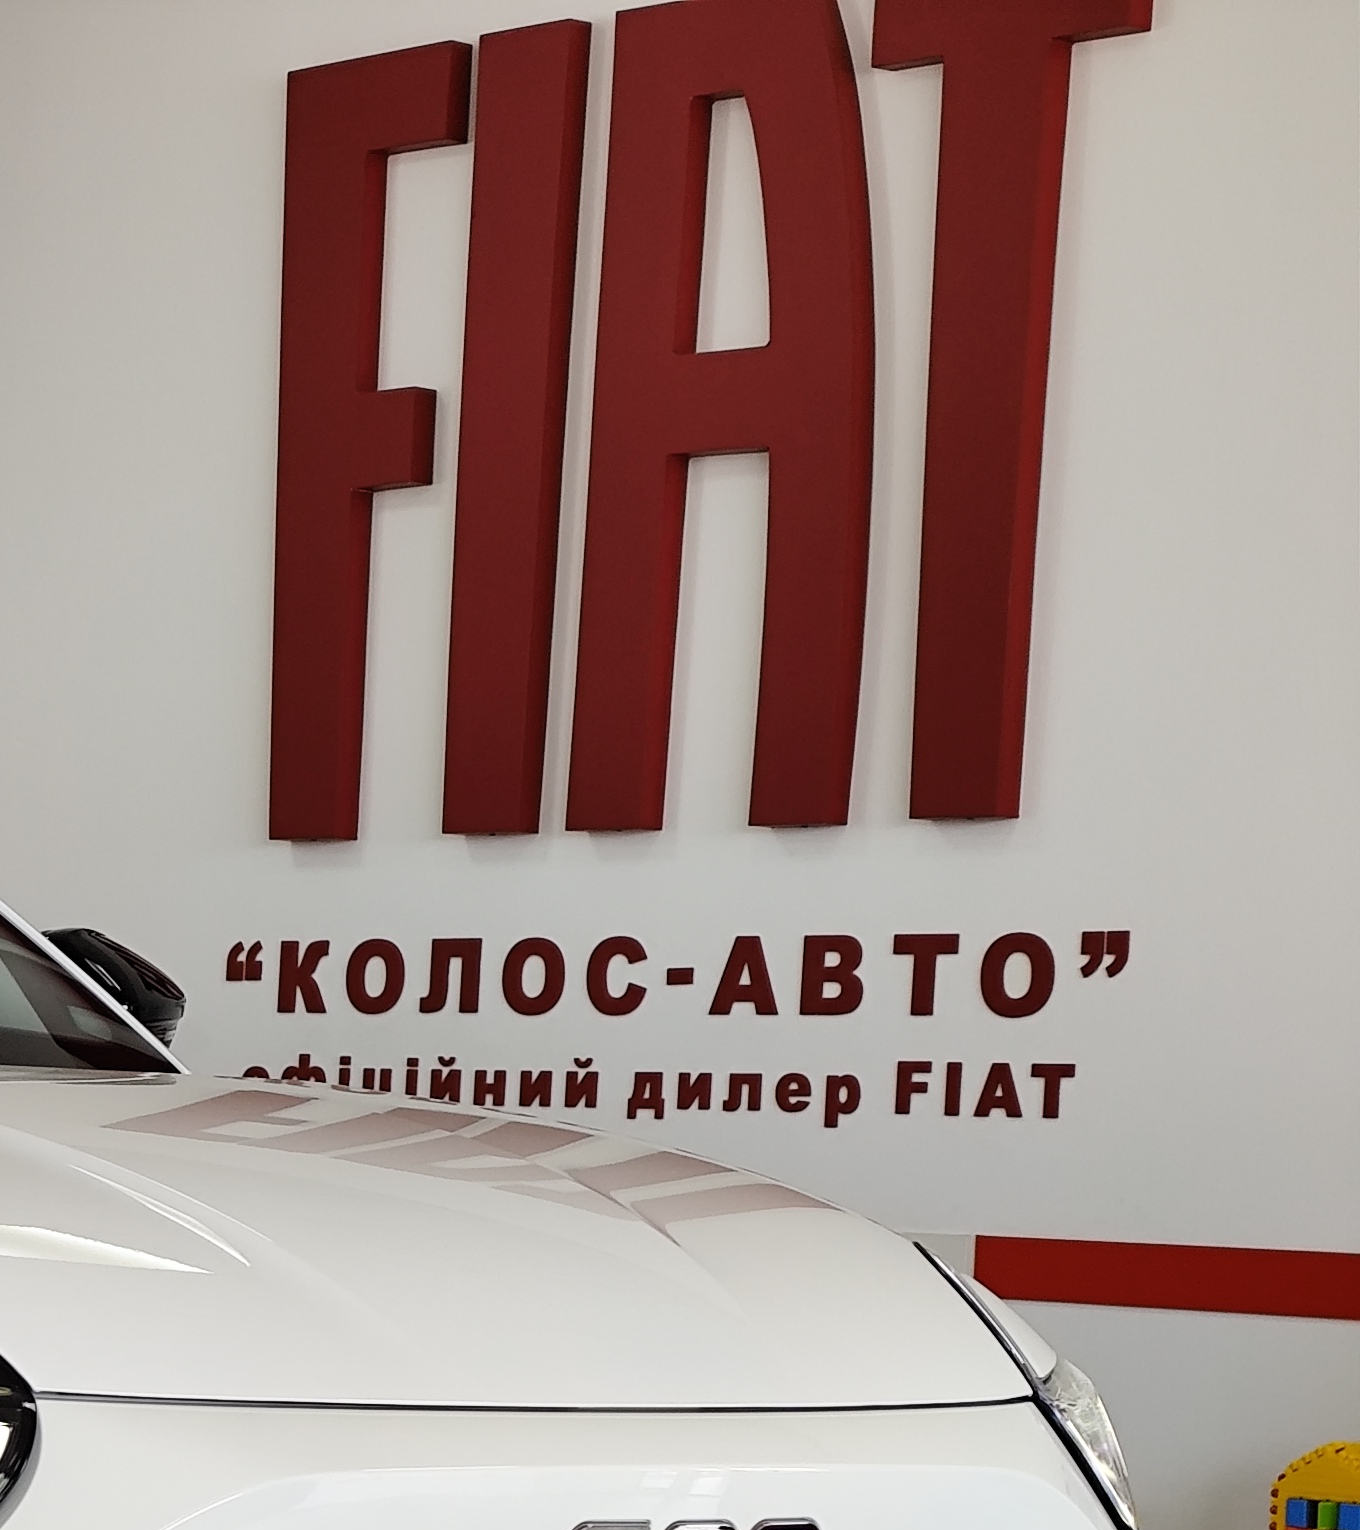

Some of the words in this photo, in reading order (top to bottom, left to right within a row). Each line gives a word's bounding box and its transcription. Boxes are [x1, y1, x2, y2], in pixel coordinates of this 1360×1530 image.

[269, 0, 1152, 842] FIAT
[626, 1063, 862, 1128] дилер
[894, 1061, 1076, 1119] FIAT
